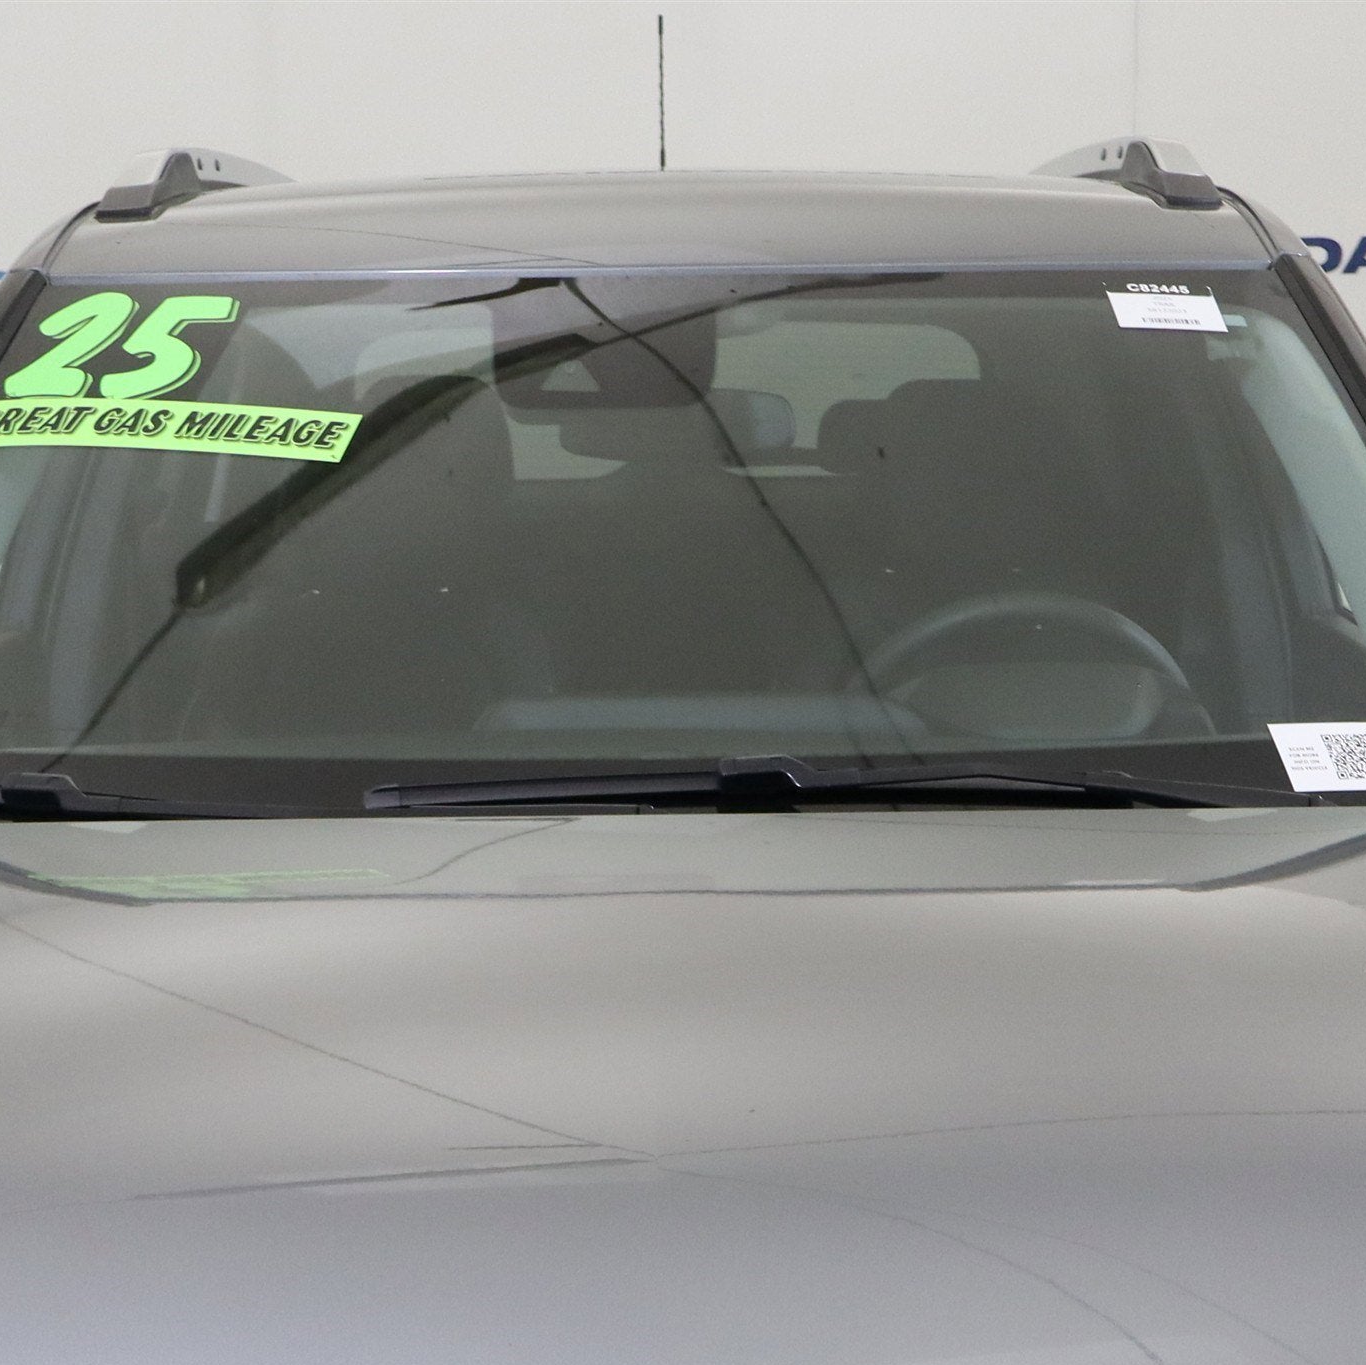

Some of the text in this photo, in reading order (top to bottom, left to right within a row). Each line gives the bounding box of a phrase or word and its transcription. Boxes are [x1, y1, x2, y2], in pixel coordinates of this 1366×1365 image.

[3, 291, 241, 400] 25
[93, 406, 175, 438] GAS
[173, 409, 350, 451] MILEAGE
